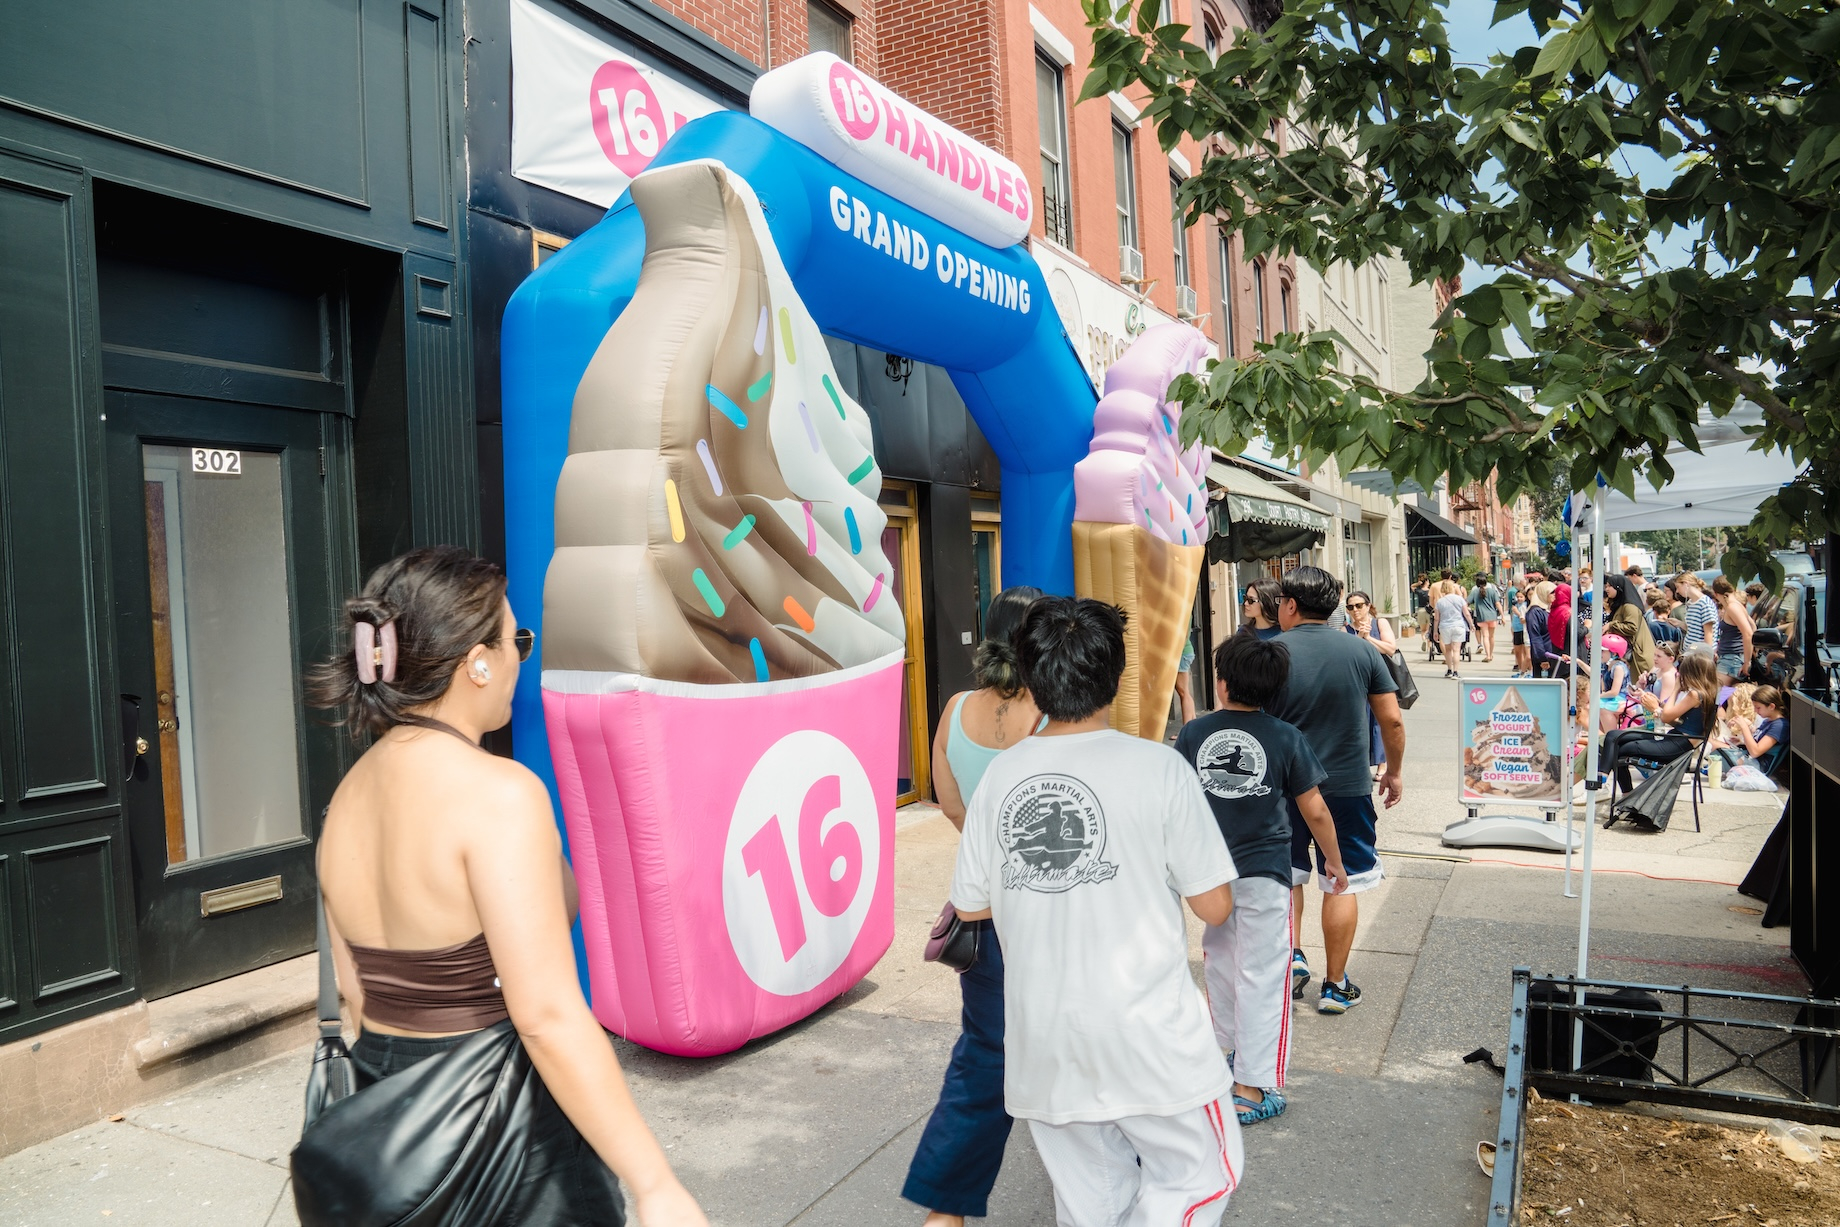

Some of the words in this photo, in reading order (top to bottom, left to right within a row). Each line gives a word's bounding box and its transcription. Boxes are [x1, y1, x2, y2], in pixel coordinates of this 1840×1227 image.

[598, 87, 660, 158] 16
[834, 77, 876, 124] 16
[882, 106, 1030, 221] HANDLES
[829, 185, 930, 271] GRAND
[935, 243, 1031, 315] OPENING
[195, 451, 239, 472] 302
[1472, 691, 1485, 702] 16
[1492, 712, 1531, 723] Frozen
[1200, 733, 1228, 765] CHAMPIONS
[1230, 733, 1256, 751] MARTIAL
[1255, 751, 1264, 770] ARTS
[1493, 745, 1531, 756] Cream
[1503, 738, 1519, 746] ICE
[1483, 773, 1508, 781] SOFT
[1510, 774, 1540, 782] SERVE
[1495, 762, 1529, 773] Vegan
[1001, 784, 1036, 844] CHAMPIONS
[1041, 782, 1086, 806] MARTIAL
[1084, 806, 1099, 837] ARTS
[742, 775, 863, 963] 16
